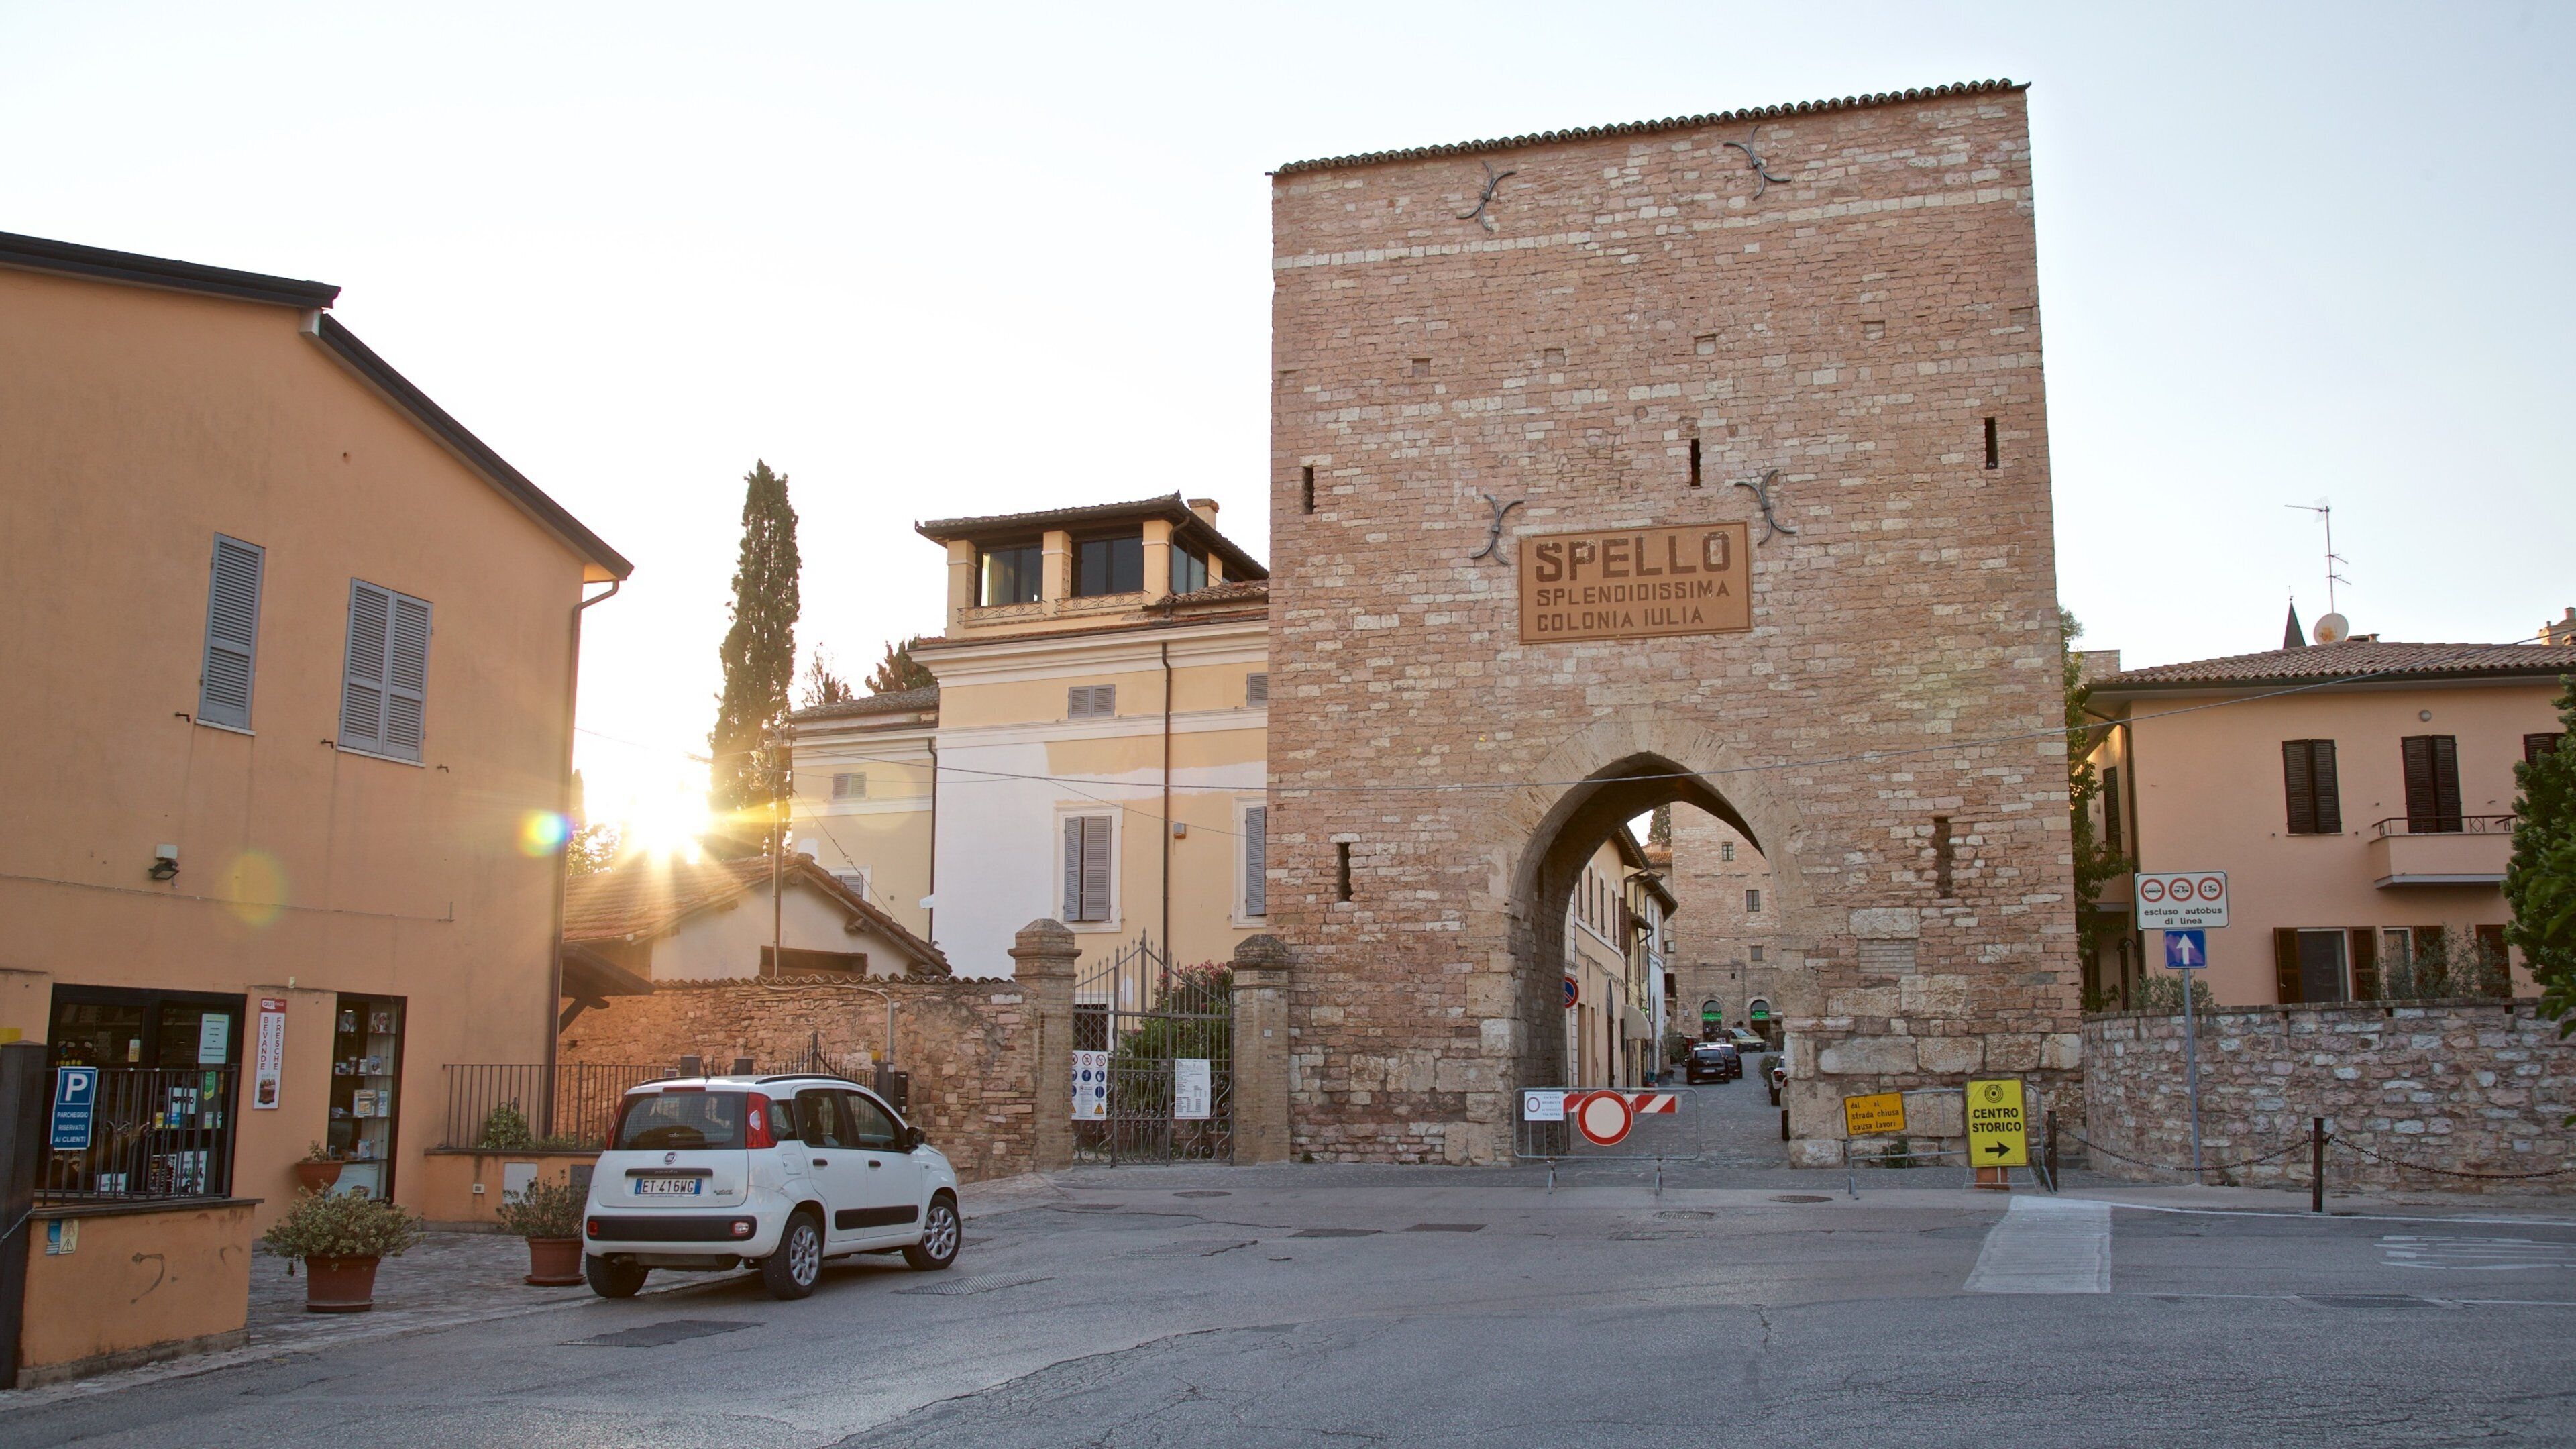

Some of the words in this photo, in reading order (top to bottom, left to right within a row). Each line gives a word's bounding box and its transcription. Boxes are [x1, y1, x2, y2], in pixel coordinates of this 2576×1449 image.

[1536, 531, 1731, 582] SPELLO
[1537, 580, 1730, 606] SPLENDIDISSIMA
[1537, 610, 1634, 632] COLONIA
[1644, 606, 1704, 627] IULIA
[260, 1016, 268, 1070] BEVANDE
[274, 1017, 282, 1070] FRESCHE
[65, 1073, 88, 1102] P
[1851, 1111, 1874, 1120] strada
[1877, 1109, 1899, 1117] chiusa
[1876, 1119, 1896, 1128] lavori
[1973, 1108, 2019, 1119] CENTRO
[1972, 1122, 2021, 1132] STORICO
